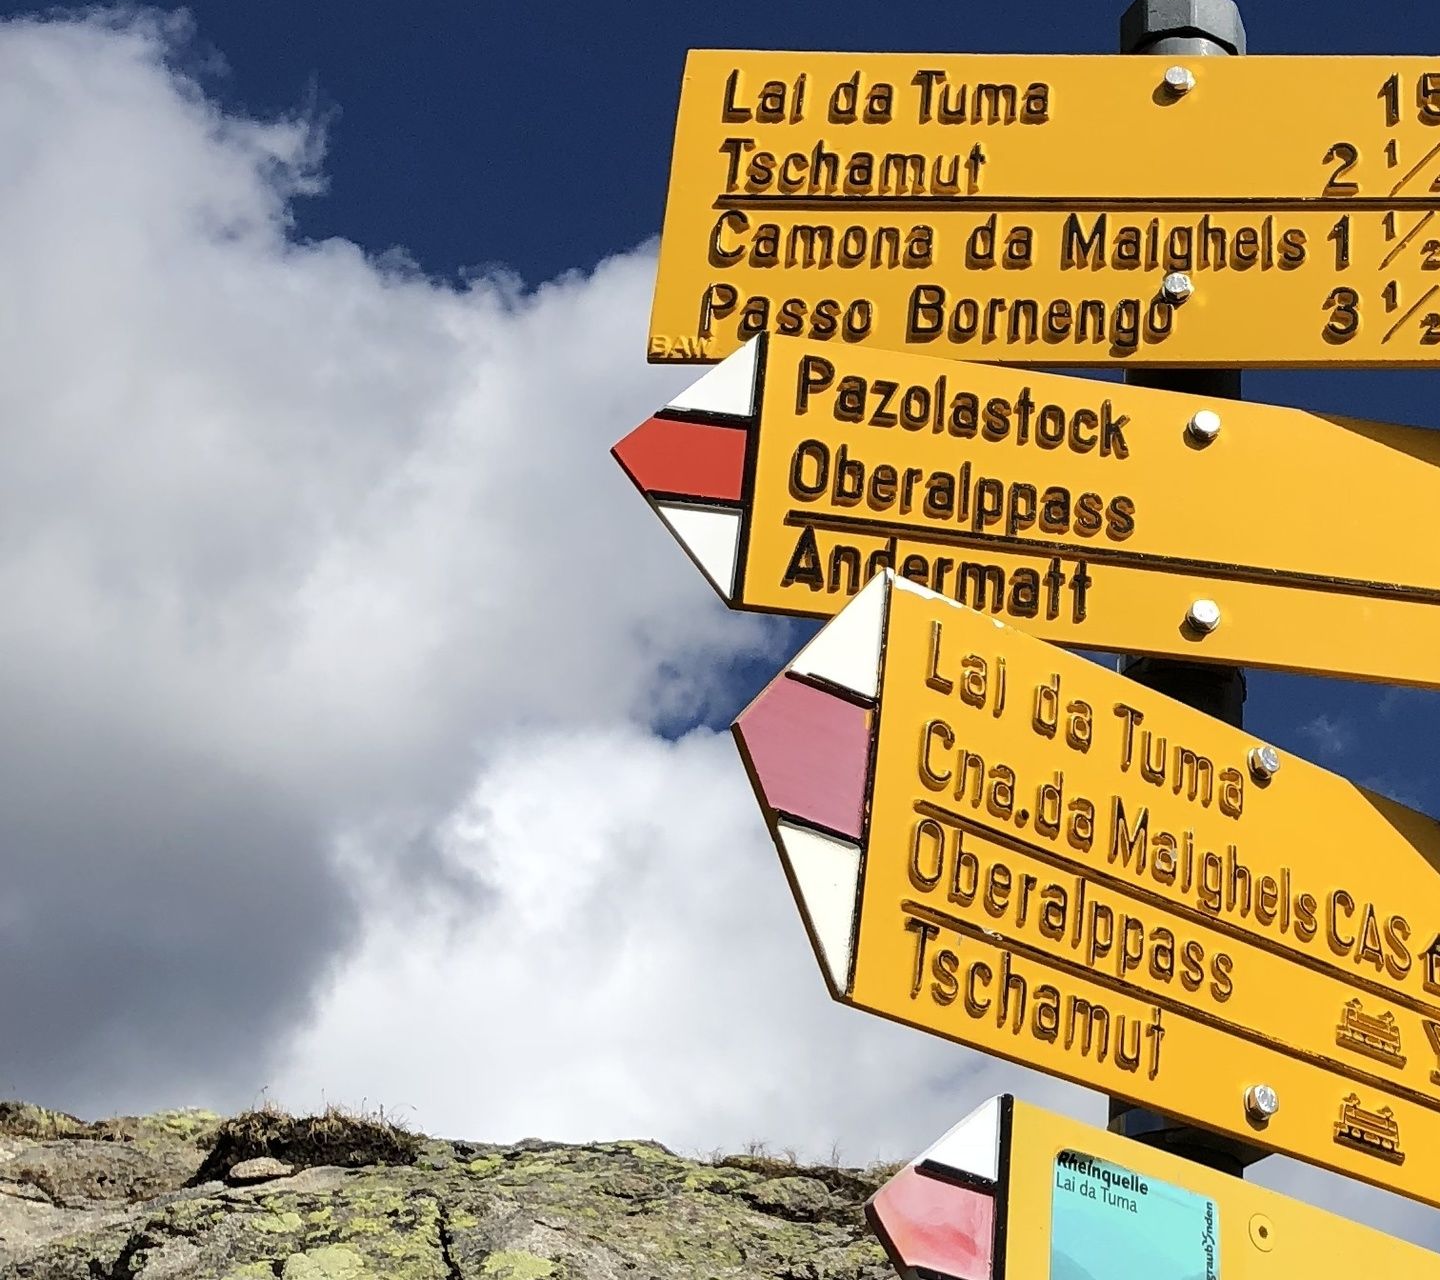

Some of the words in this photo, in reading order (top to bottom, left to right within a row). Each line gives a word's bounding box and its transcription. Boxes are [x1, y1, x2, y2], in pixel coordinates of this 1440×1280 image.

[722, 68, 806, 123] Lai
[828, 71, 894, 123] da
[913, 70, 1051, 124] Tuma
[719, 138, 987, 195] Tschamut
[709, 210, 934, 269] Camona
[966, 214, 1034, 270] da
[1061, 213, 1306, 272] Maighels
[701, 283, 872, 340] Passo
[906, 285, 1174, 357] Bornengo
[796, 355, 1131, 459] Pazolastock
[788, 439, 1135, 540] Oberalppass
[925, 620, 1007, 717] Lai
[1032, 673, 1094, 754] da
[1114, 702, 1245, 819] Tuma
[909, 818, 1234, 1002] Oberalppass
[905, 917, 1165, 1080] Tschamut
[1057, 1150, 1148, 1195] Rheinquelle
[1057, 1171, 1075, 1192] Lai
[1080, 1180, 1096, 1200] da
[1100, 1186, 1138, 1213] Tuma
